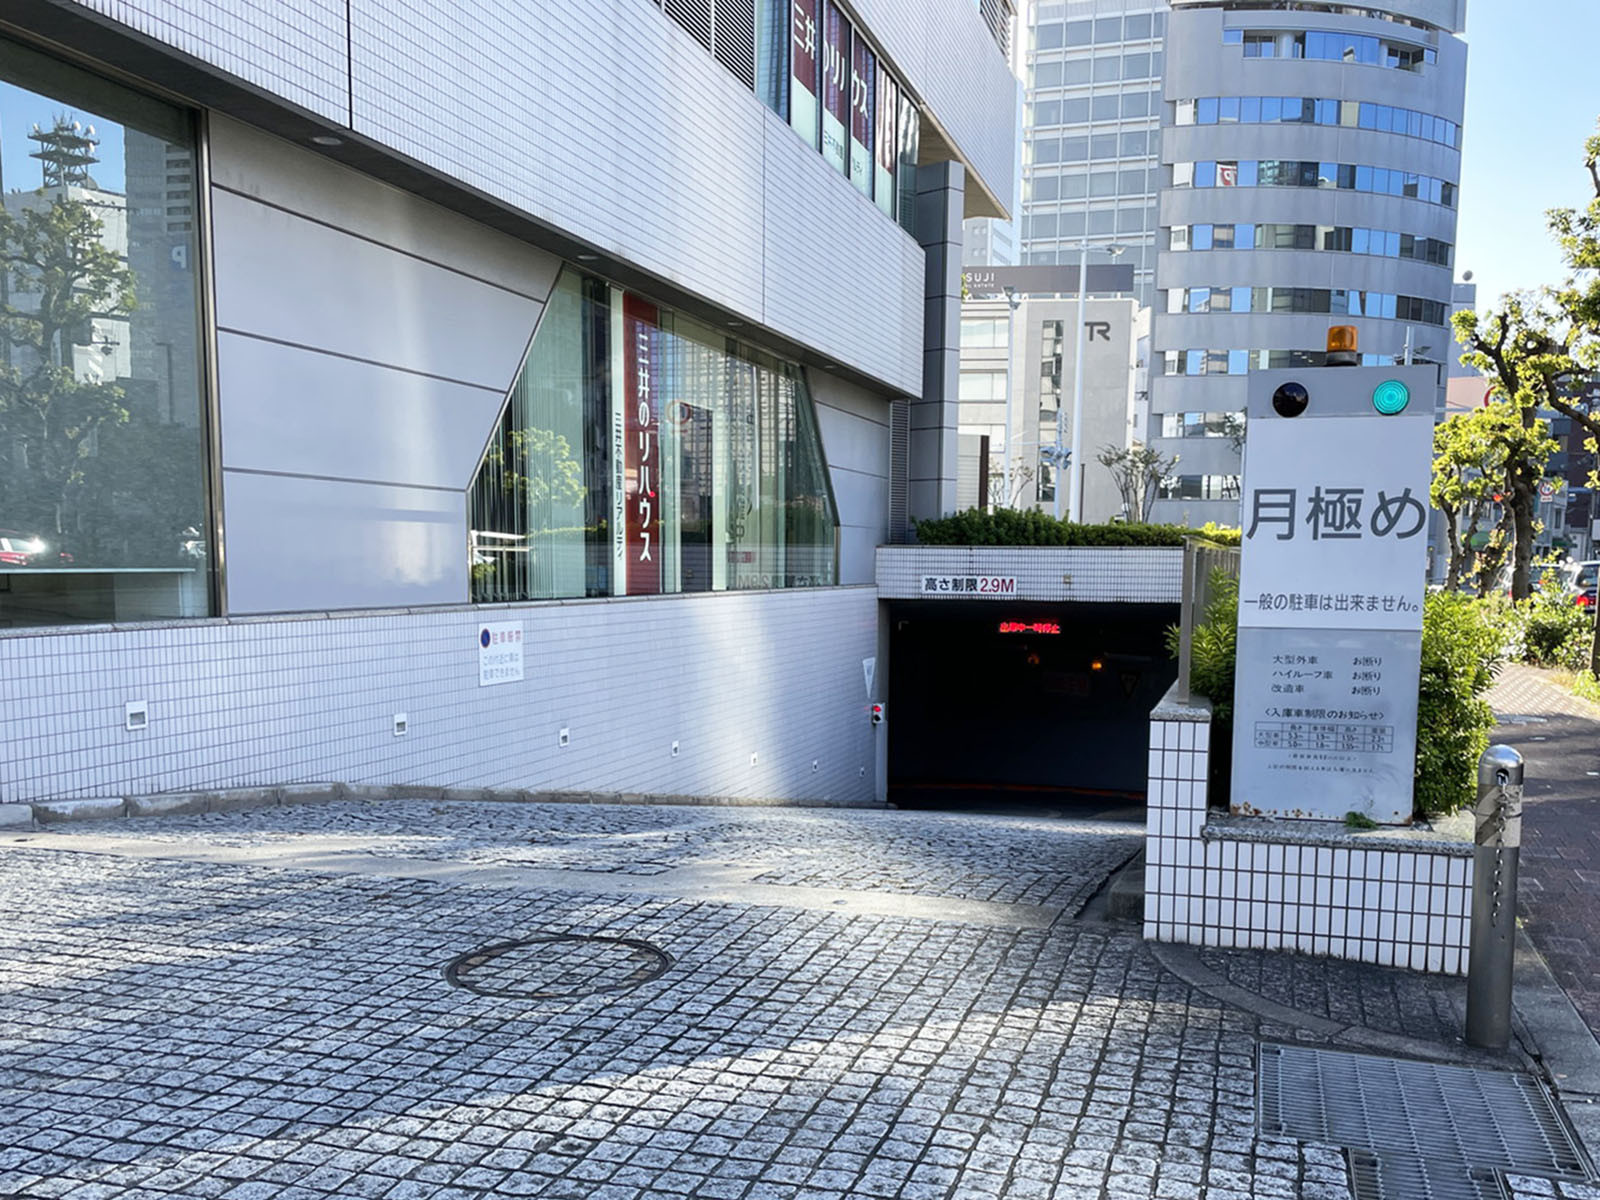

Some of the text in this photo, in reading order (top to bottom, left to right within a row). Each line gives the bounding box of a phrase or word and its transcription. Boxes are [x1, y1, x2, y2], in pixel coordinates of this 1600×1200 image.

[1083, 320, 1111, 342] TR
[637, 332, 655, 563] 三井のリハウス
[1245, 486, 1427, 541] 月極め
[1243, 593, 1420, 613] 一般の駐車は出来ません。
[1273, 655, 1318, 665] 大型外車
[1353, 655, 1382, 666] お断り
[1272, 670, 1333, 680] ハイルーフ車
[1352, 671, 1381, 681] お断り
[1271, 684, 1304, 694] 改造車
[1351, 686, 1381, 696] お断り
